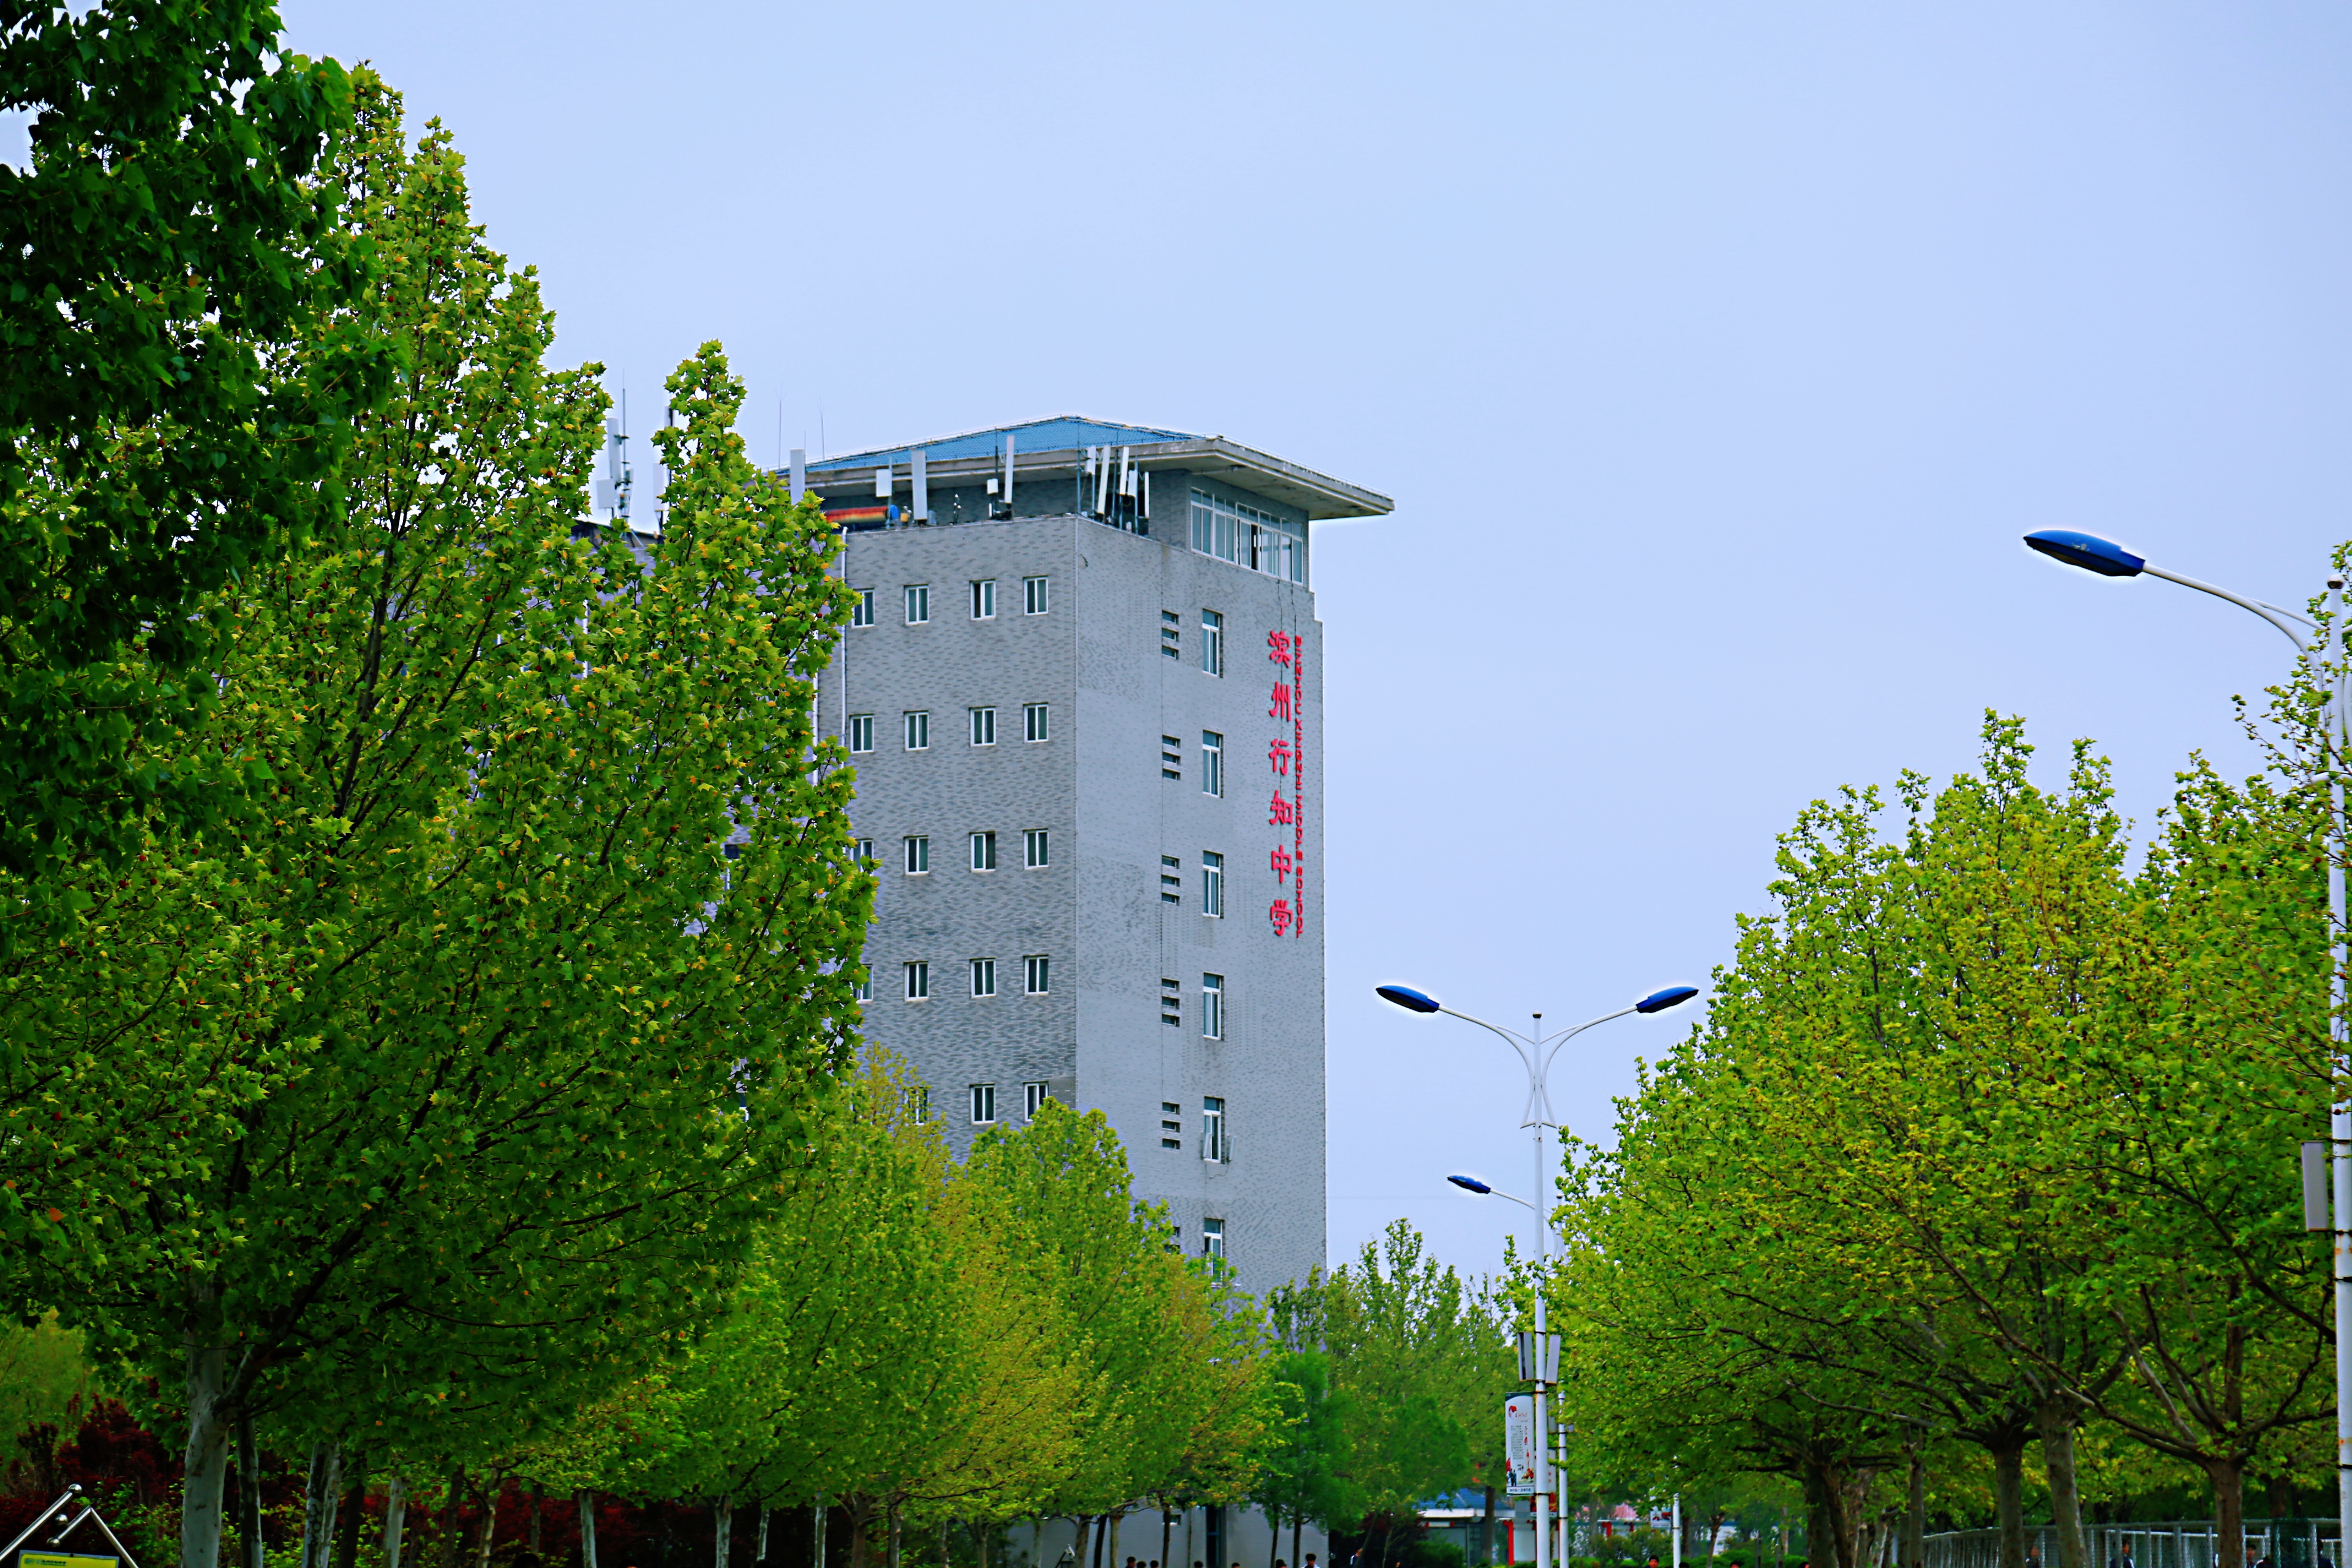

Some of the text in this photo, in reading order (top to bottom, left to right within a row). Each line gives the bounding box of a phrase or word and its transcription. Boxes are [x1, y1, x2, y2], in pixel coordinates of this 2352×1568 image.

[1268, 630, 1294, 937] 滨州行知中学
[1295, 865, 1304, 939] SCHOOL
